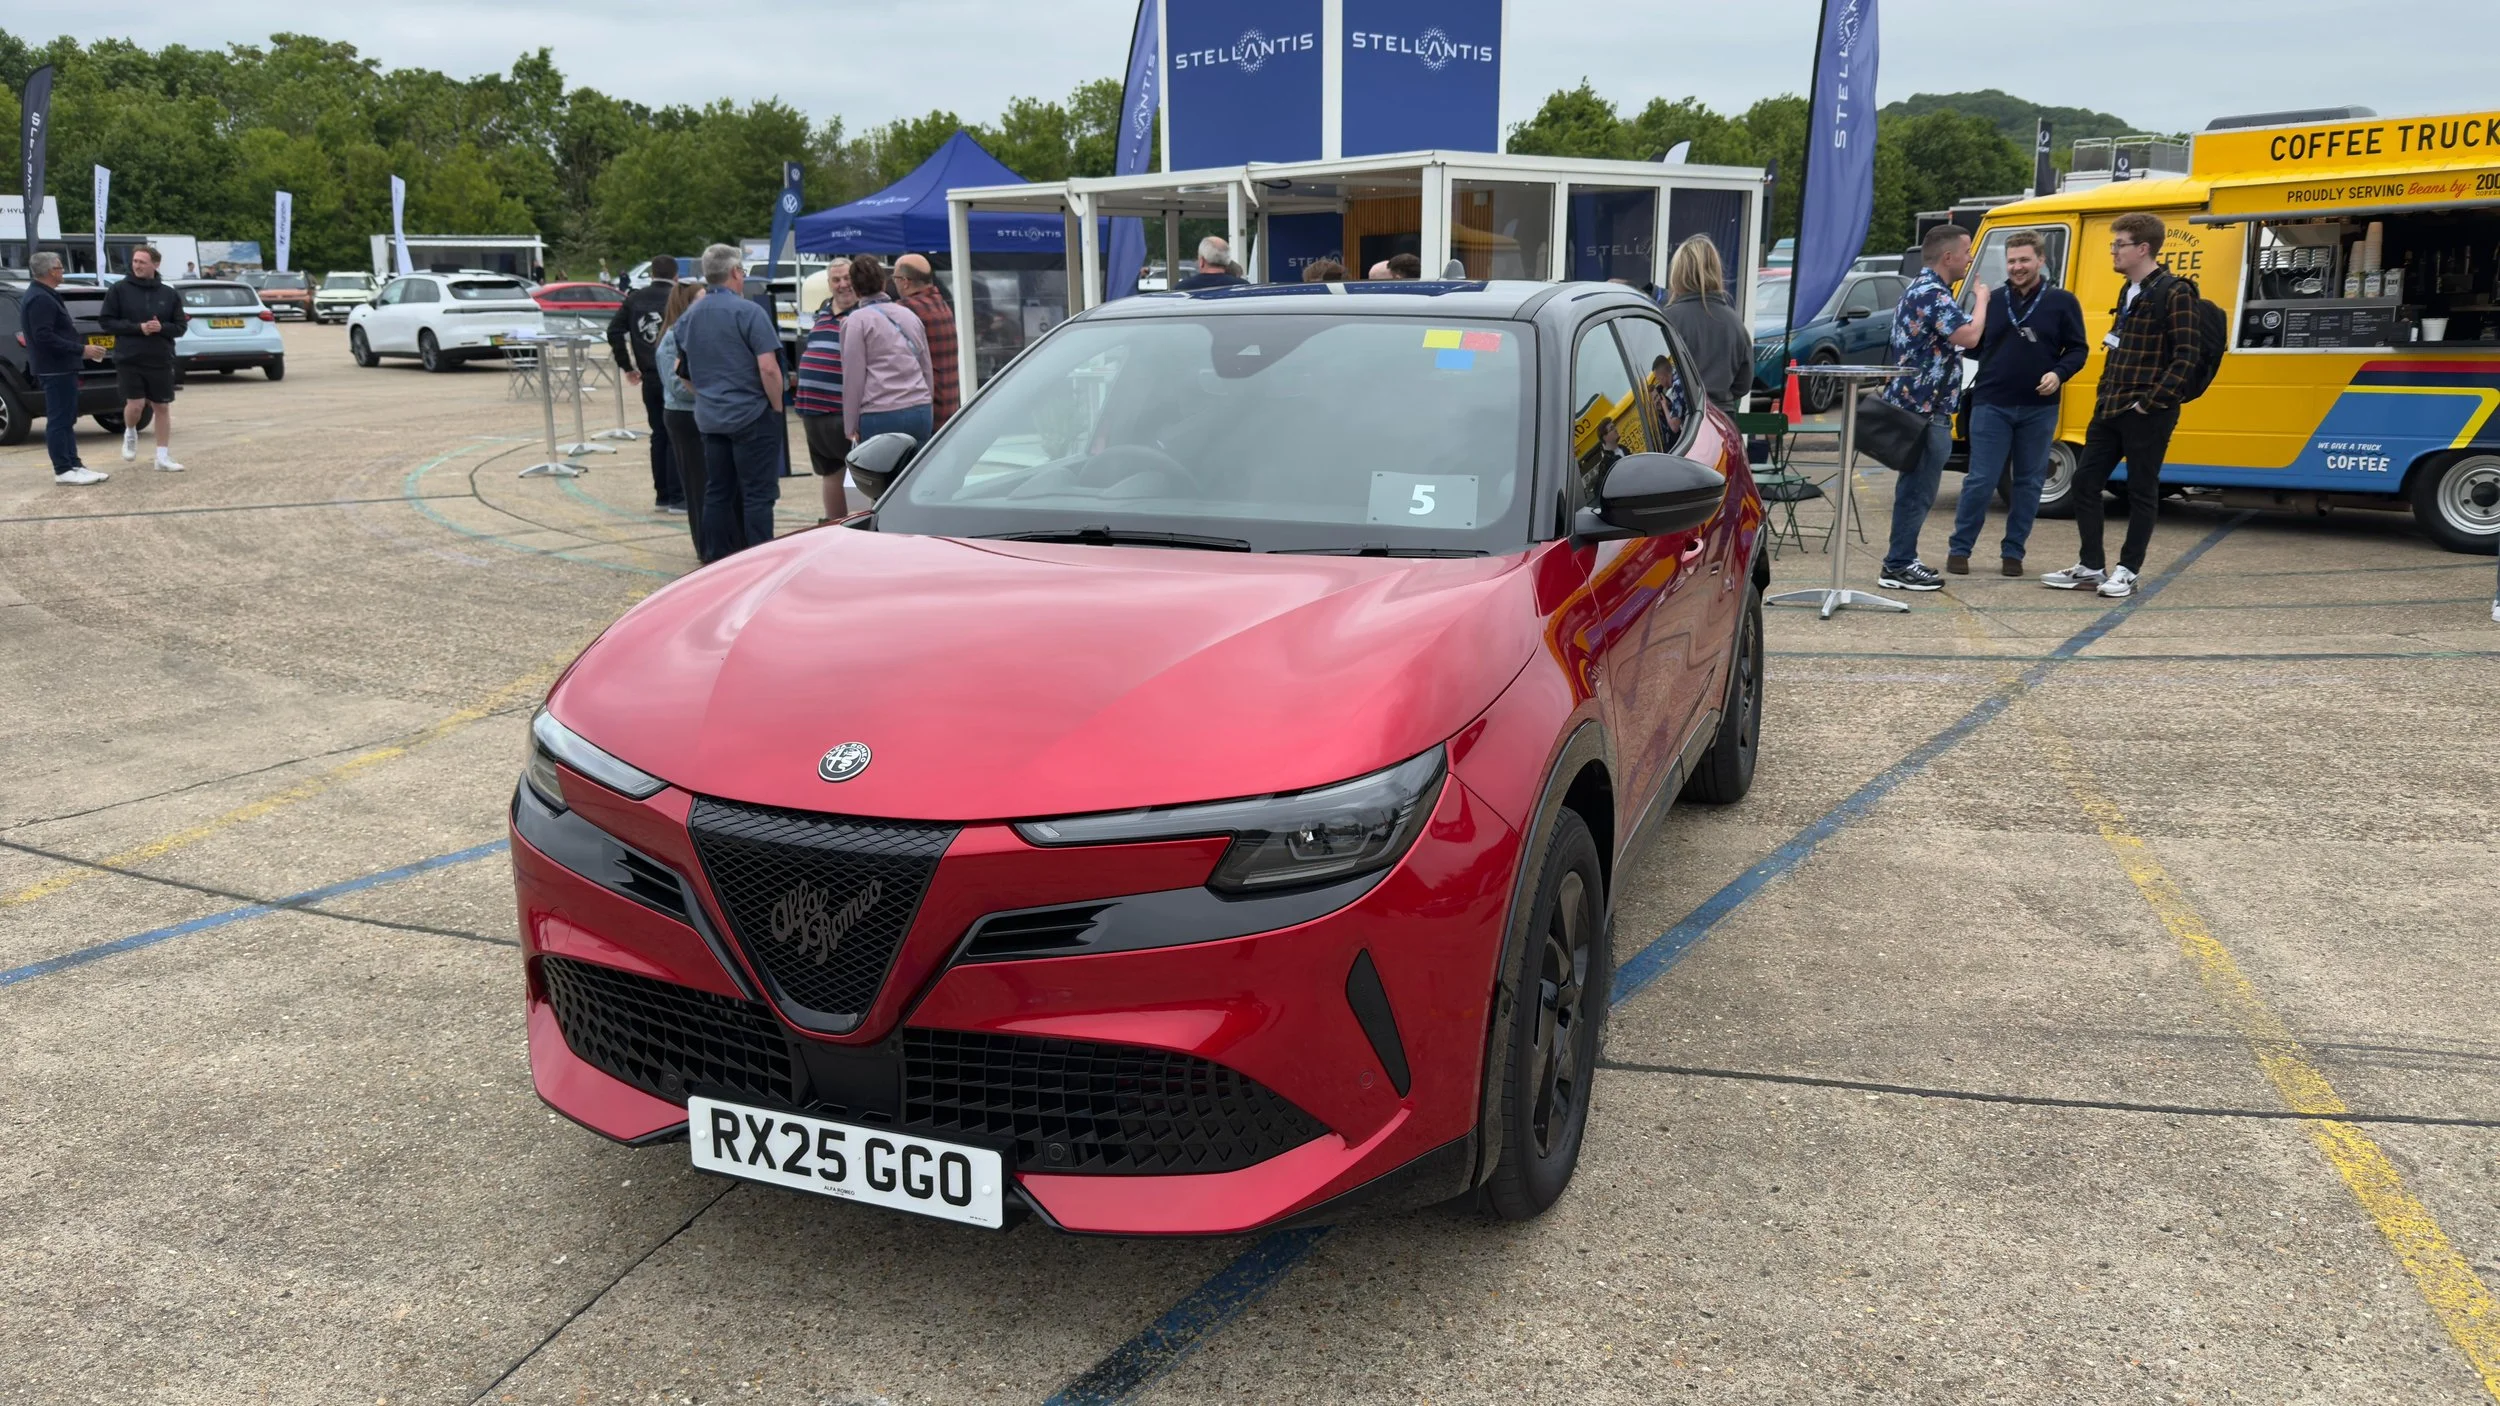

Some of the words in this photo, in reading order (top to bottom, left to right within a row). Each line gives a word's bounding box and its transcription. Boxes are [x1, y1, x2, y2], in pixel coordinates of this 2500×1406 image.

[1175, 33, 1314, 69] STELLANTIS
[1351, 31, 1493, 63] STELLANTIS
[2270, 127, 2384, 162] COFFEE
[2287, 187, 2346, 203] PROUDLY
[2349, 183, 2405, 200] SERVING
[2408, 181, 2447, 195] Beans
[997, 229, 1062, 238] STELLANTIS
[2167, 228, 2200, 248] DRINKS
[2317, 441, 2329, 449] WE
[2331, 442, 2349, 450] GIVE
[2358, 443, 2382, 451] TRUCK
[2326, 455, 2390, 472] COFFEE
[1408, 484, 1436, 515] 5
[771, 879, 829, 956] Alfa
[806, 879, 882, 966] Romeo
[710, 1107, 847, 1183] RX25
[864, 1137, 972, 1207] GGO
